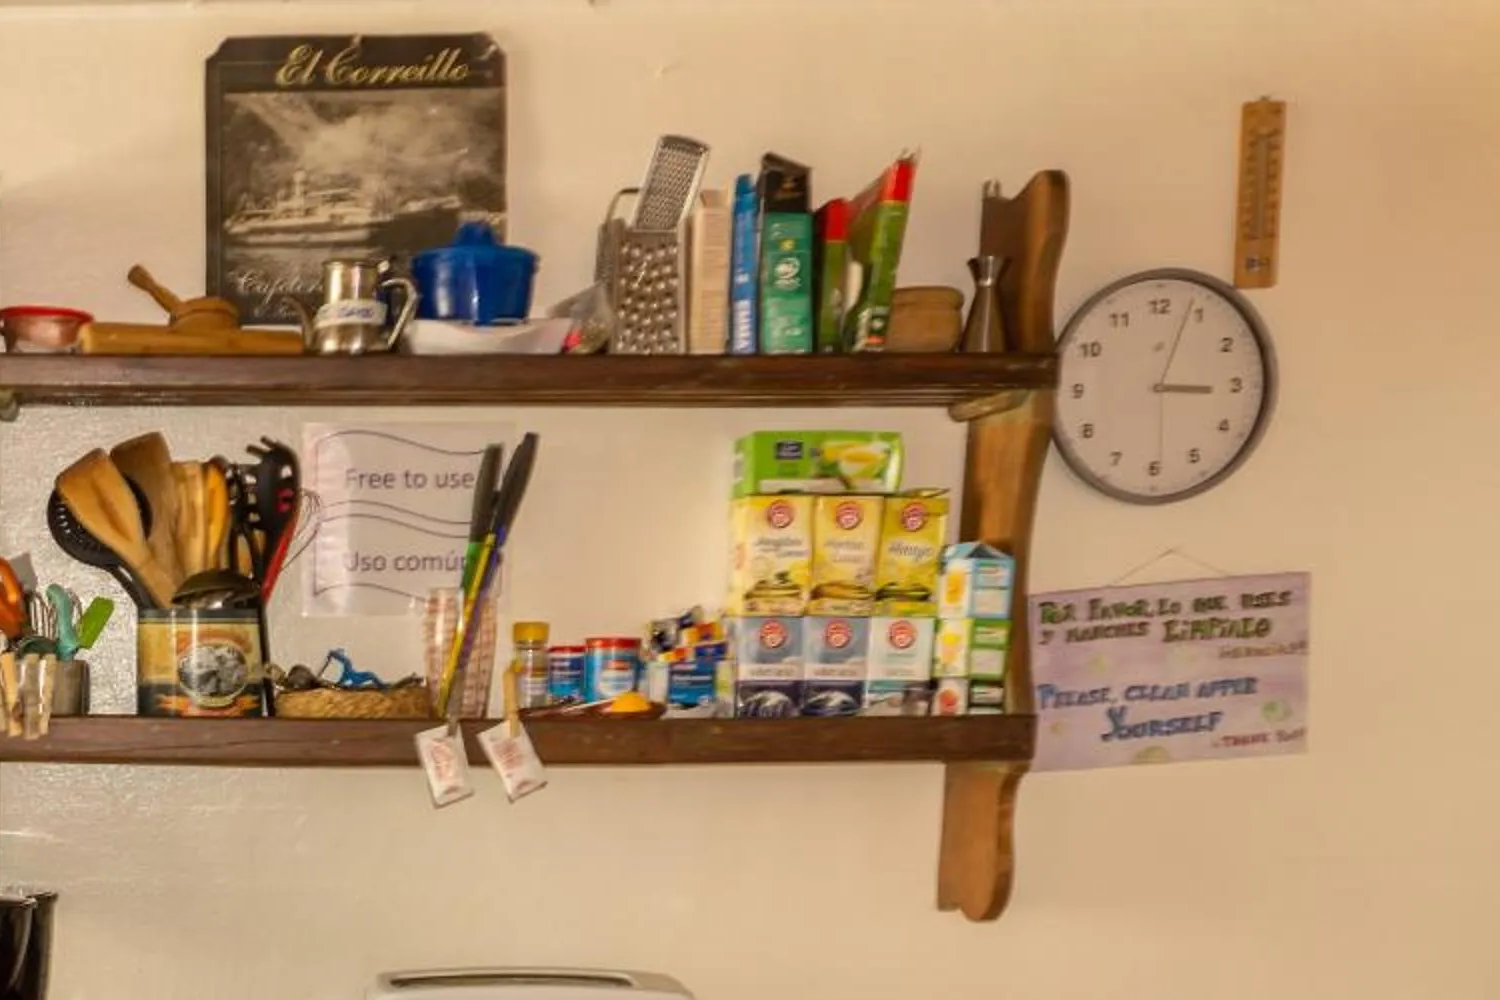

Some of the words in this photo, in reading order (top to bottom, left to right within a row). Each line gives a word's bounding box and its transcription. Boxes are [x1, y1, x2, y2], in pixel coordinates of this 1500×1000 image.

[275, 43, 324, 87] El
[325, 46, 471, 85] Correillo
[1150, 299, 1171, 315] 12
[1109, 312, 1130, 328] 11
[1194, 308, 1204, 323] 1
[1080, 342, 1102, 358] 10
[1220, 337, 1234, 353] 2
[1072, 383, 1085, 399] 9
[1230, 377, 1243, 394] 3
[1082, 423, 1094, 439] 8
[1217, 419, 1230, 432] 4
[1110, 451, 1123, 467] 7
[1188, 448, 1201, 464] 5
[1148, 461, 1161, 477] 6
[345, 468, 396, 489] Free
[404, 469, 428, 489] to
[435, 471, 475, 489] use
[1124, 681, 1190, 701] CLEAN
[1100, 705, 1223, 743] YOURSELF
